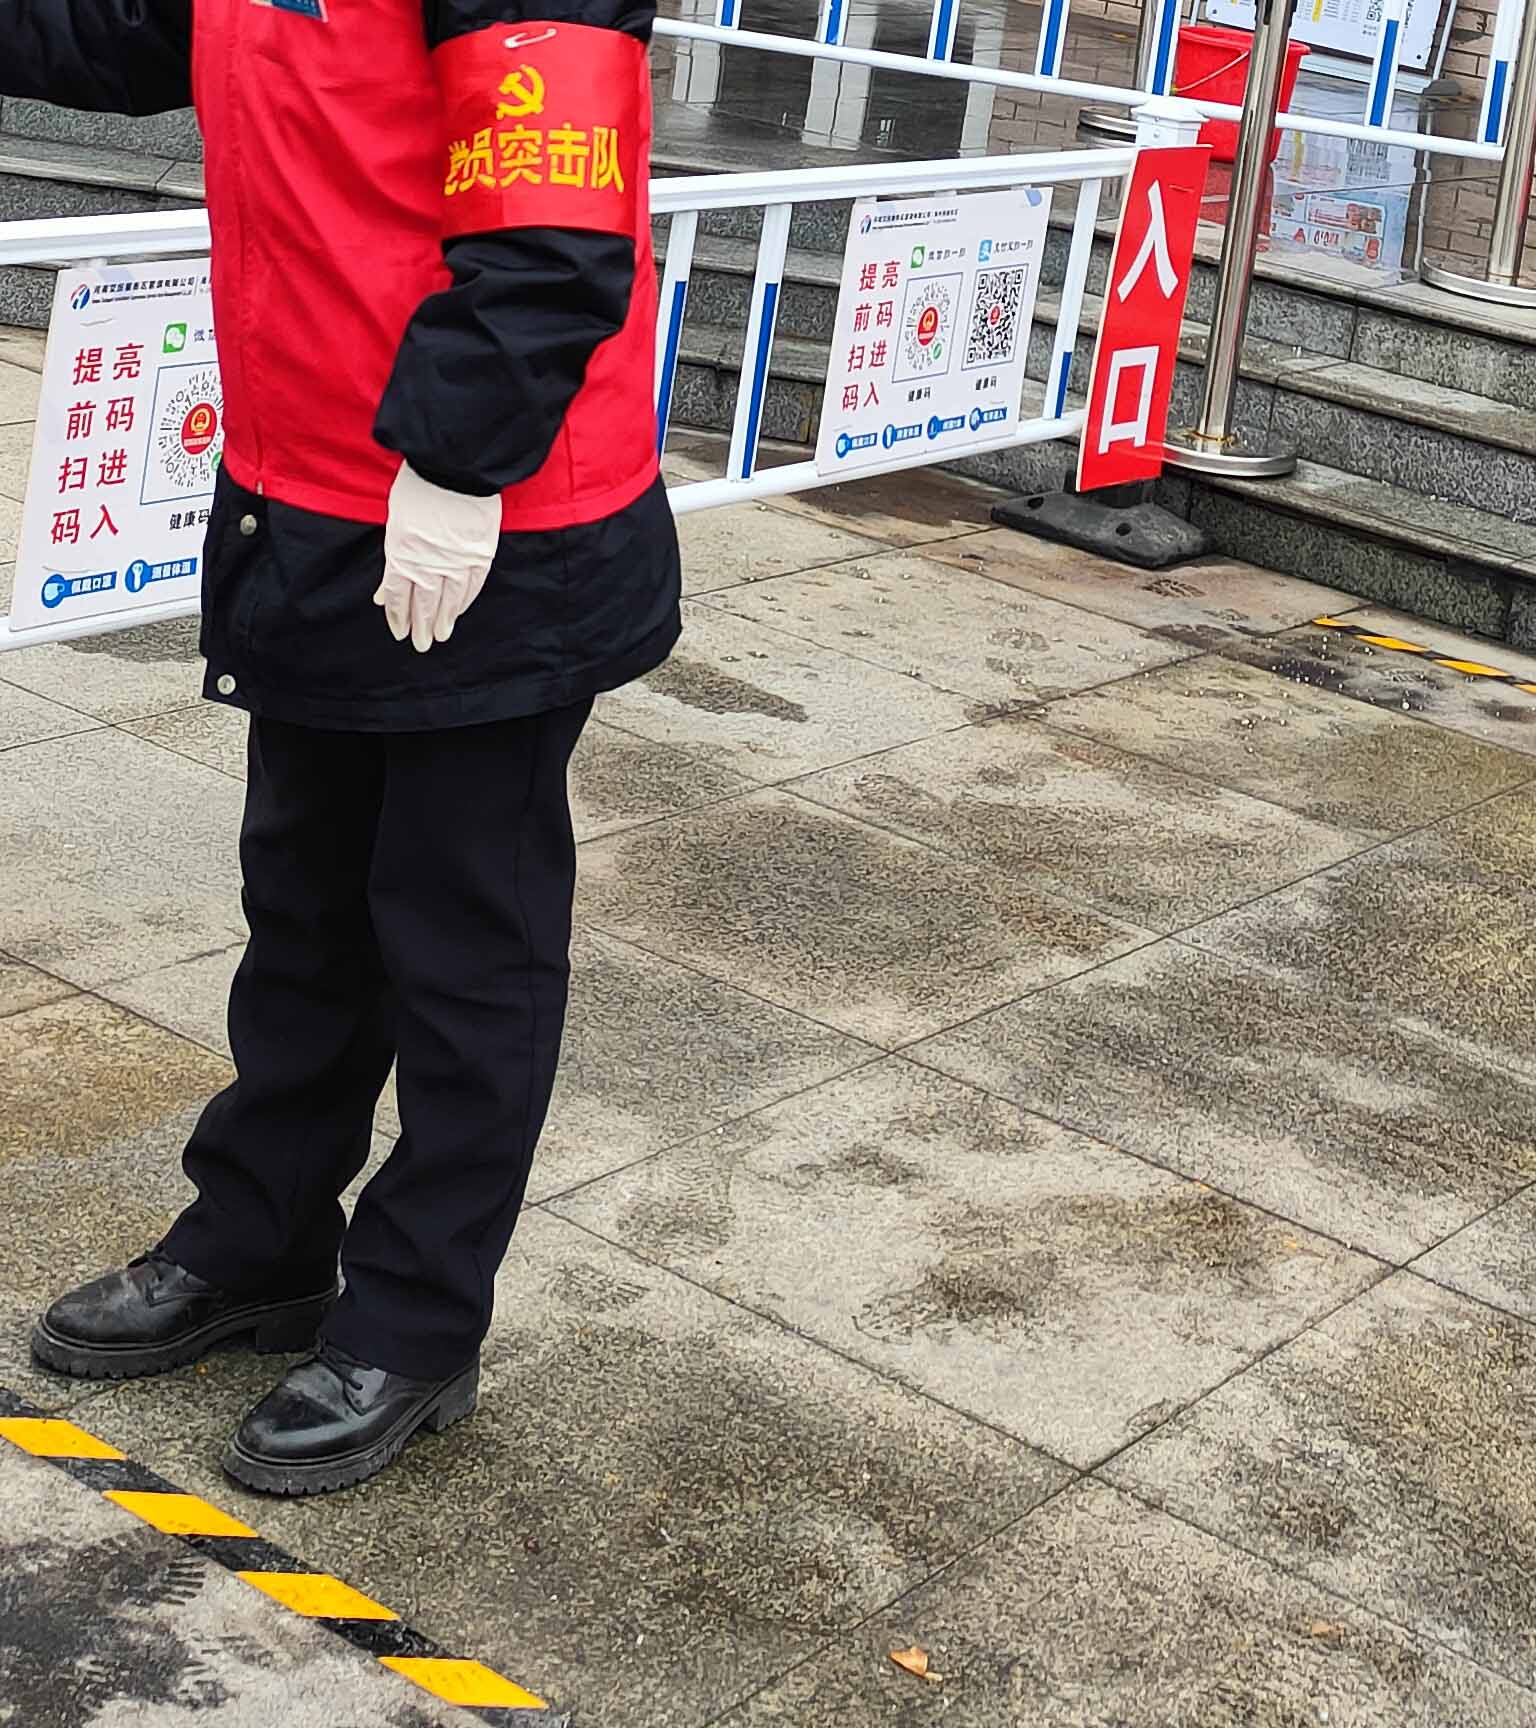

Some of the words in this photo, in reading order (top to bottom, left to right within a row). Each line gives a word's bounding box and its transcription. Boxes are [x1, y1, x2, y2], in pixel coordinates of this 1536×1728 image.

[1097, 179, 1180, 456] 入口
[51, 347, 104, 546] 提前扫码
[90, 342, 145, 540] 亮码进入
